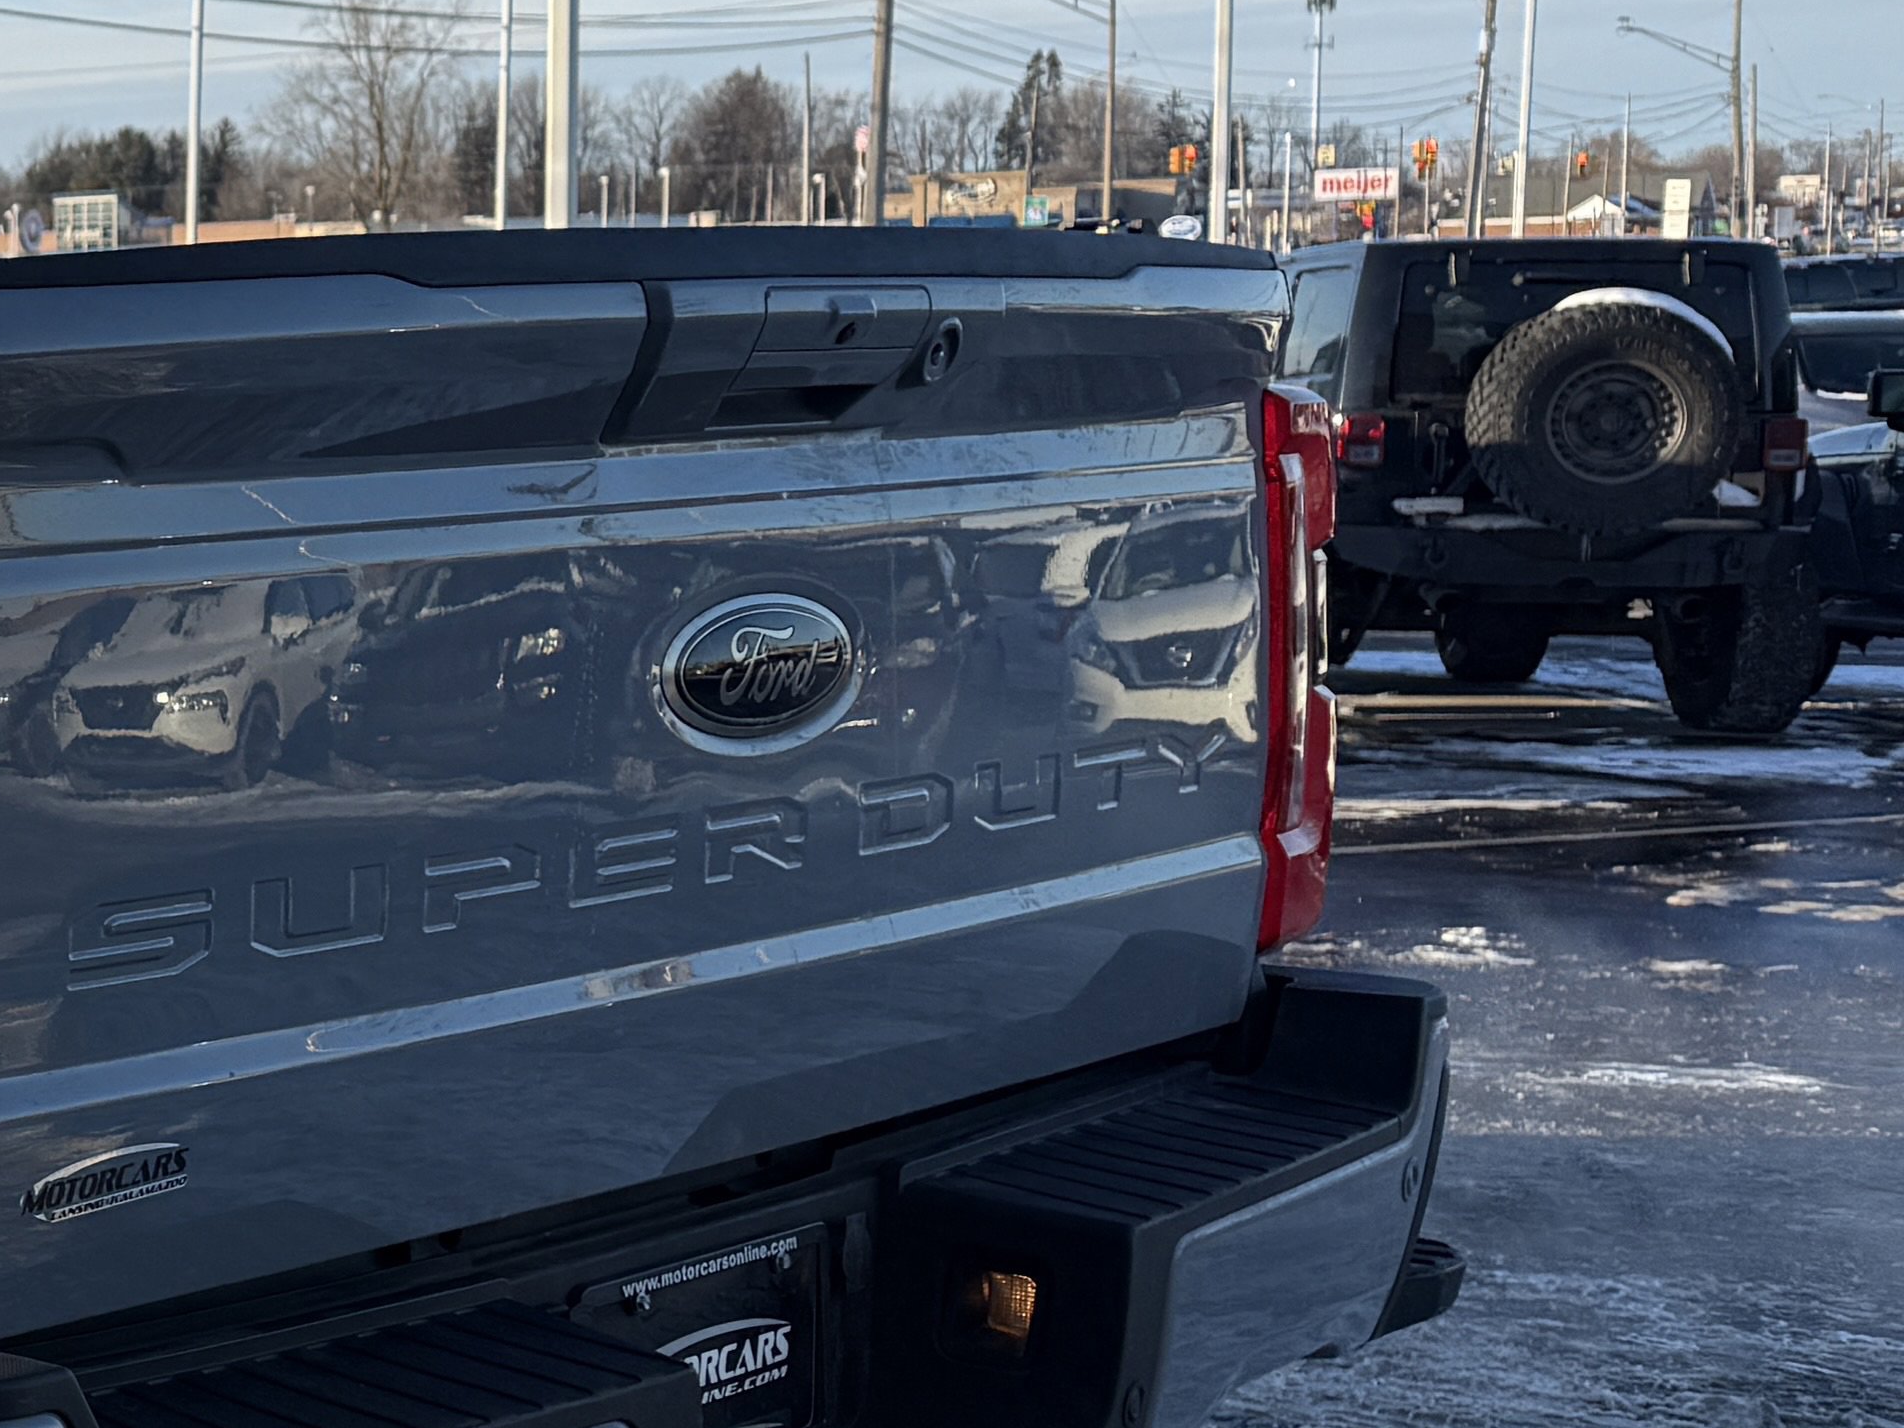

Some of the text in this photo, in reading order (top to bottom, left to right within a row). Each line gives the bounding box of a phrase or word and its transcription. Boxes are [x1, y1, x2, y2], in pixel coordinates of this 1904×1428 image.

[1321, 169, 1392, 194] meijer
[719, 625, 841, 707] Ford
[66, 733, 1228, 992] SUPER DUTY
[20, 1147, 190, 1216] MOTORCARS
[621, 1235, 799, 1299] www.motorcarsonline.com
[701, 1364, 789, 1405] INE.COM
